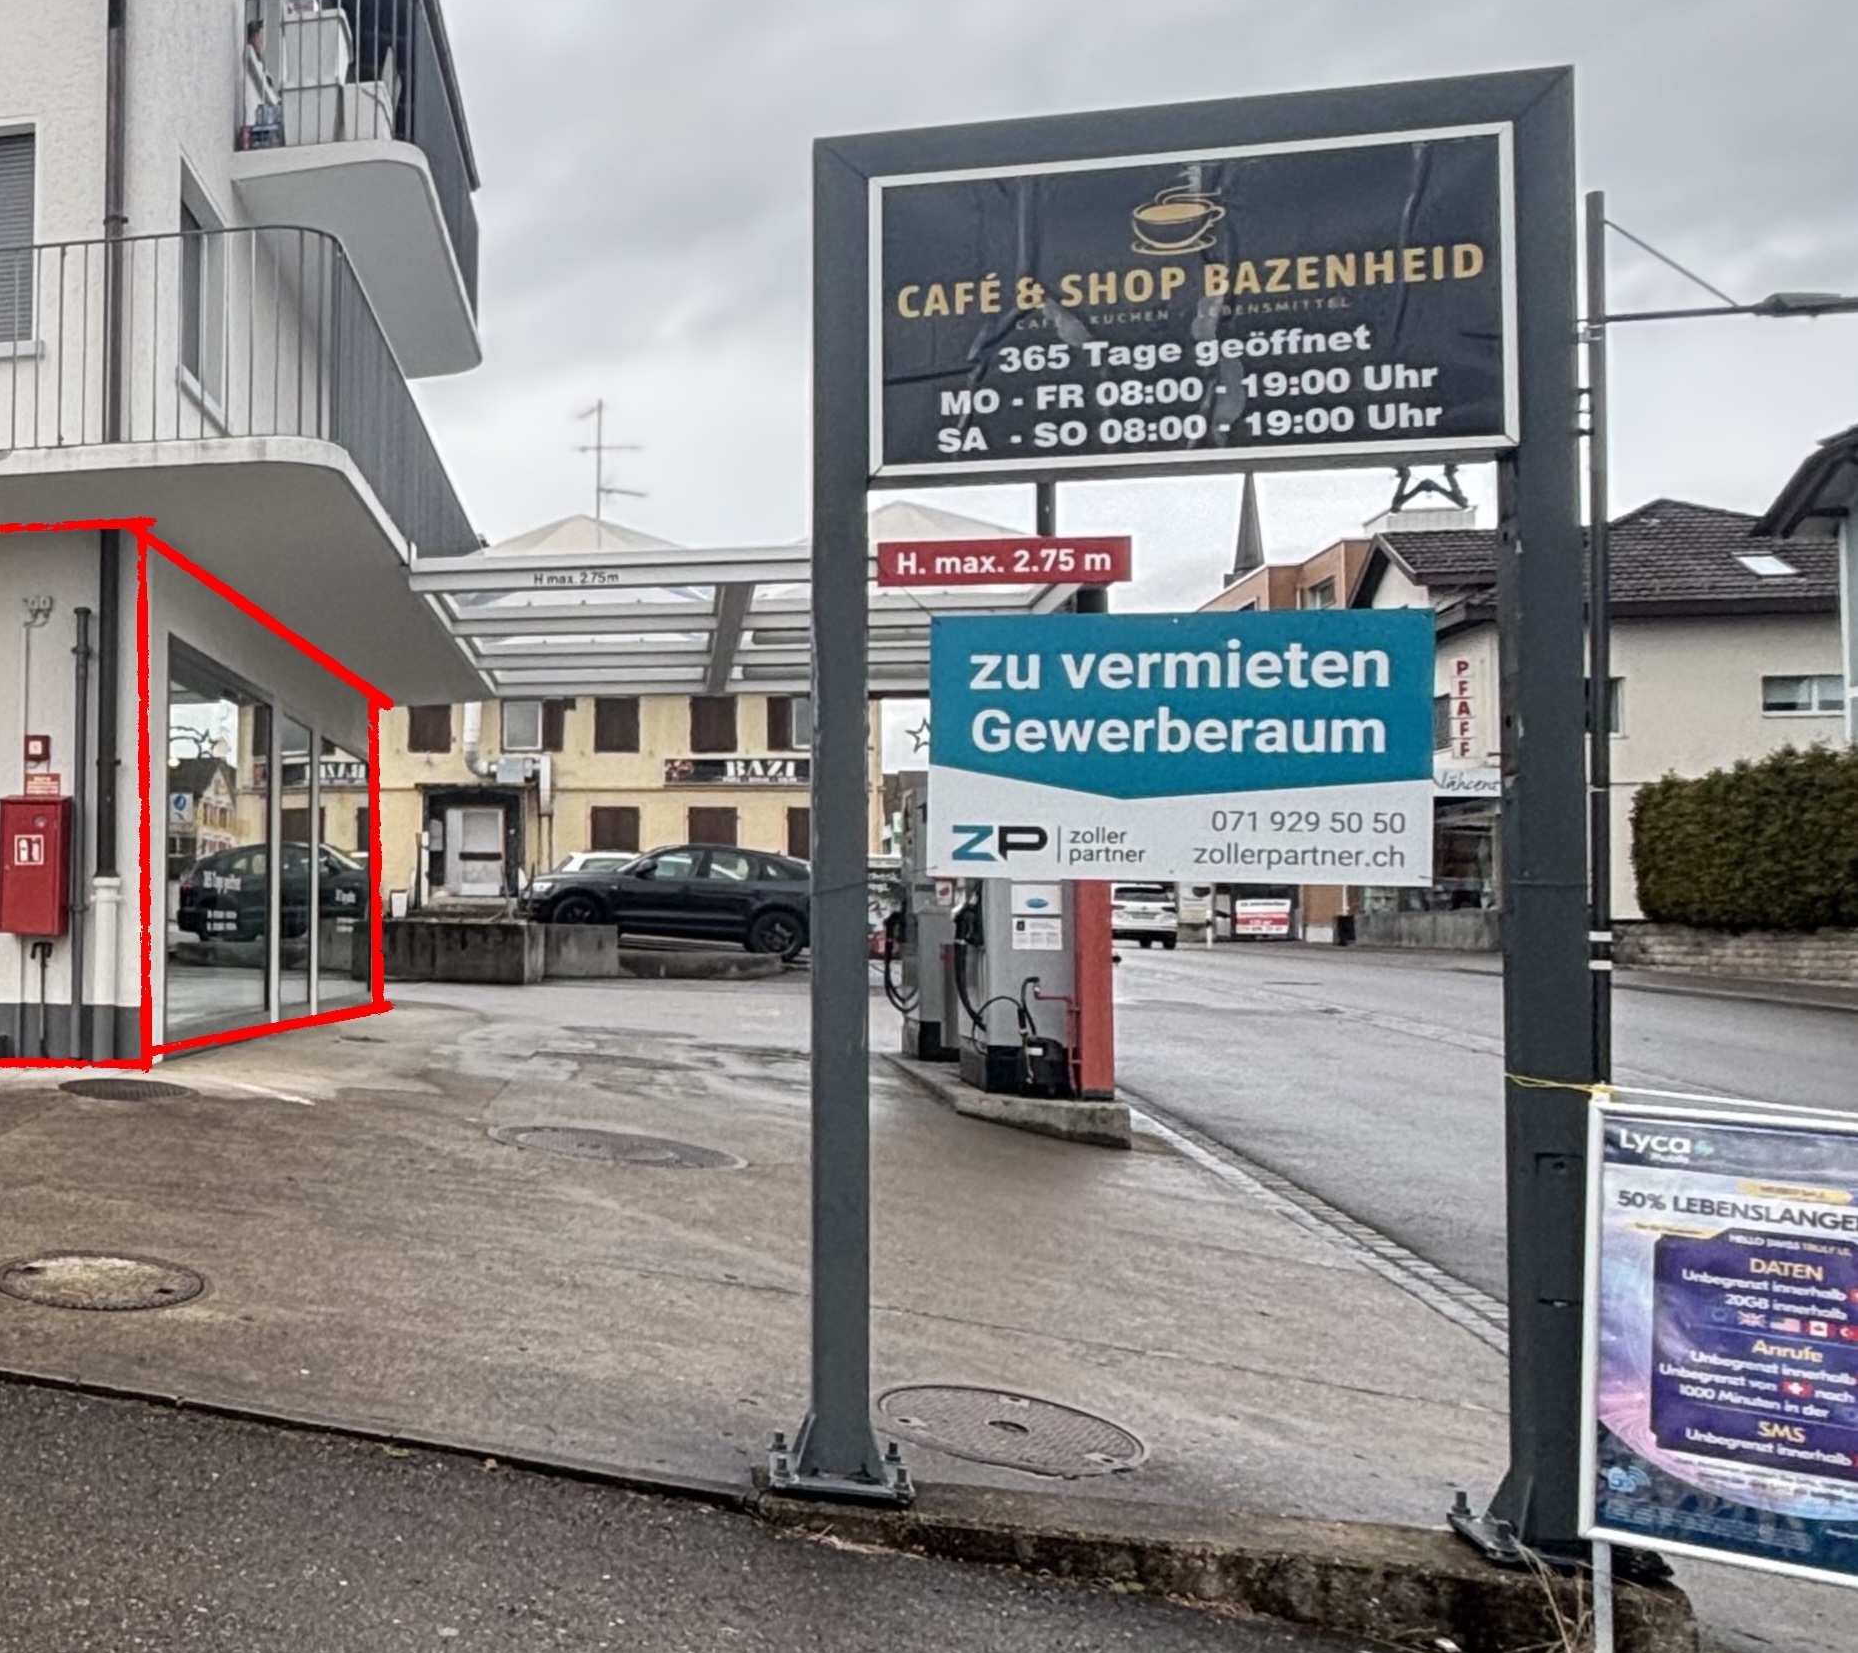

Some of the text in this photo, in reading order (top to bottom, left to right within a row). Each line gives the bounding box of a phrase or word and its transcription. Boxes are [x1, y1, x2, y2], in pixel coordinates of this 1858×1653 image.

[897, 243, 1484, 318] CAFÉ & SHOP BAZENHEID
[998, 323, 1371, 373] 365 Tage geöffnet
[940, 389, 1000, 416] MO
[1036, 384, 1084, 410] FR
[1095, 376, 1203, 406] 08:00
[1242, 368, 1350, 397] 19:00
[1364, 364, 1438, 391] Uhr
[938, 427, 988, 453] SA
[1033, 421, 1087, 447] SO
[1099, 414, 1207, 444] 08:00
[1246, 406, 1354, 436] 19:00
[1368, 403, 1442, 430] Uhr
[897, 549, 1112, 575] H. max. 2.75 m
[970, 638, 1391, 690] zu vermieten
[1455, 660, 1472, 758] PFAFF
[971, 706, 1387, 754] Gewerberaum
[725, 760, 796, 777] BAZI
[1069, 827, 1128, 845] zoller
[1211, 811, 1406, 834] 071 929 50 50
[951, 825, 1048, 861] ZP
[1069, 846, 1145, 864] partner
[1193, 846, 1406, 868] zollerpartner.ch
[1620, 1129, 1691, 1154] Lyca
[1617, 1190, 1666, 1211] 50%
[1673, 1196, 1858, 1232] LEBENSLANGE
[1681, 1269, 1847, 1302] Unbegrenzt innerhalb
[1749, 1258, 1824, 1281] DATEN
[1725, 1293, 1847, 1320] 20GB innerhalb
[1752, 1339, 1824, 1363] Anrufe
[1659, 1362, 1746, 1387] Unbegrenzt
[1690, 1350, 1856, 1386] Unbegrenzt innerhalb
[1679, 1384, 1715, 1401] 1000
[1718, 1389, 1781, 1411] Minuten
[1802, 1403, 1830, 1418] der
[1685, 1427, 1853, 1467] Unbegrenzt innerhalb
[1757, 1420, 1807, 1443] SMS
